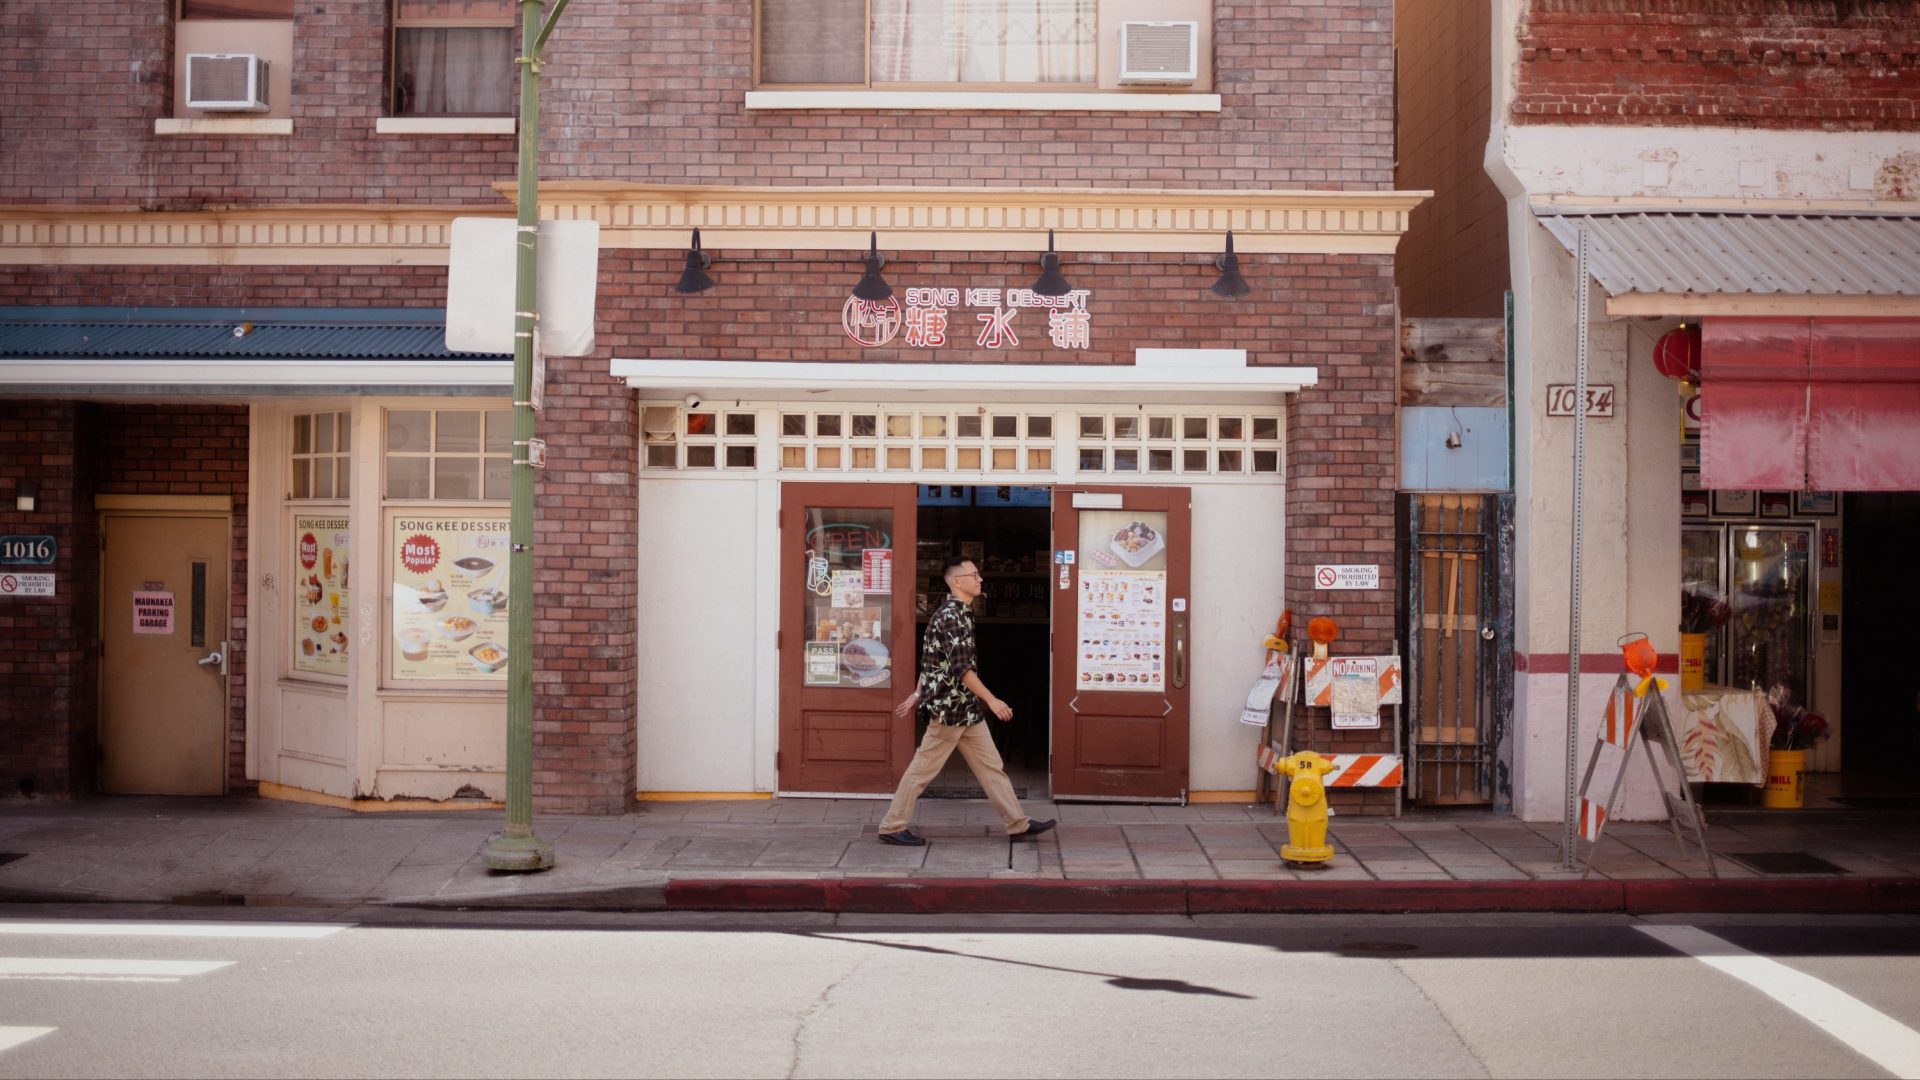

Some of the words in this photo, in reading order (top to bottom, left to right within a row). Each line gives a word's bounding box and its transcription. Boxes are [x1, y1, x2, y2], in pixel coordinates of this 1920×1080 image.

[906, 288, 959, 306] SONG
[965, 288, 1001, 306] KEE
[1007, 288, 1091, 308] DESSERT
[1551, 389, 1612, 412] 1034
[299, 520, 315, 529] SONG
[315, 520, 326, 529] KEE
[327, 520, 349, 529] DESSER
[400, 521, 433, 531] SONG
[436, 521, 458, 531] KEE
[810, 530, 881, 550] OPEN
[4, 539, 50, 558] 1016
[405, 544, 435, 556] Most
[405, 556, 436, 565] Popular
[134, 597, 173, 606] MAUNAKEA
[138, 608, 169, 617] PARKING
[139, 618, 168, 628] GARAGE
[811, 647, 834, 655] PASS
[1333, 662, 1346, 676] NO
[1346, 664, 1376, 674] PARKING
[1771, 776, 1792, 784] MILL
